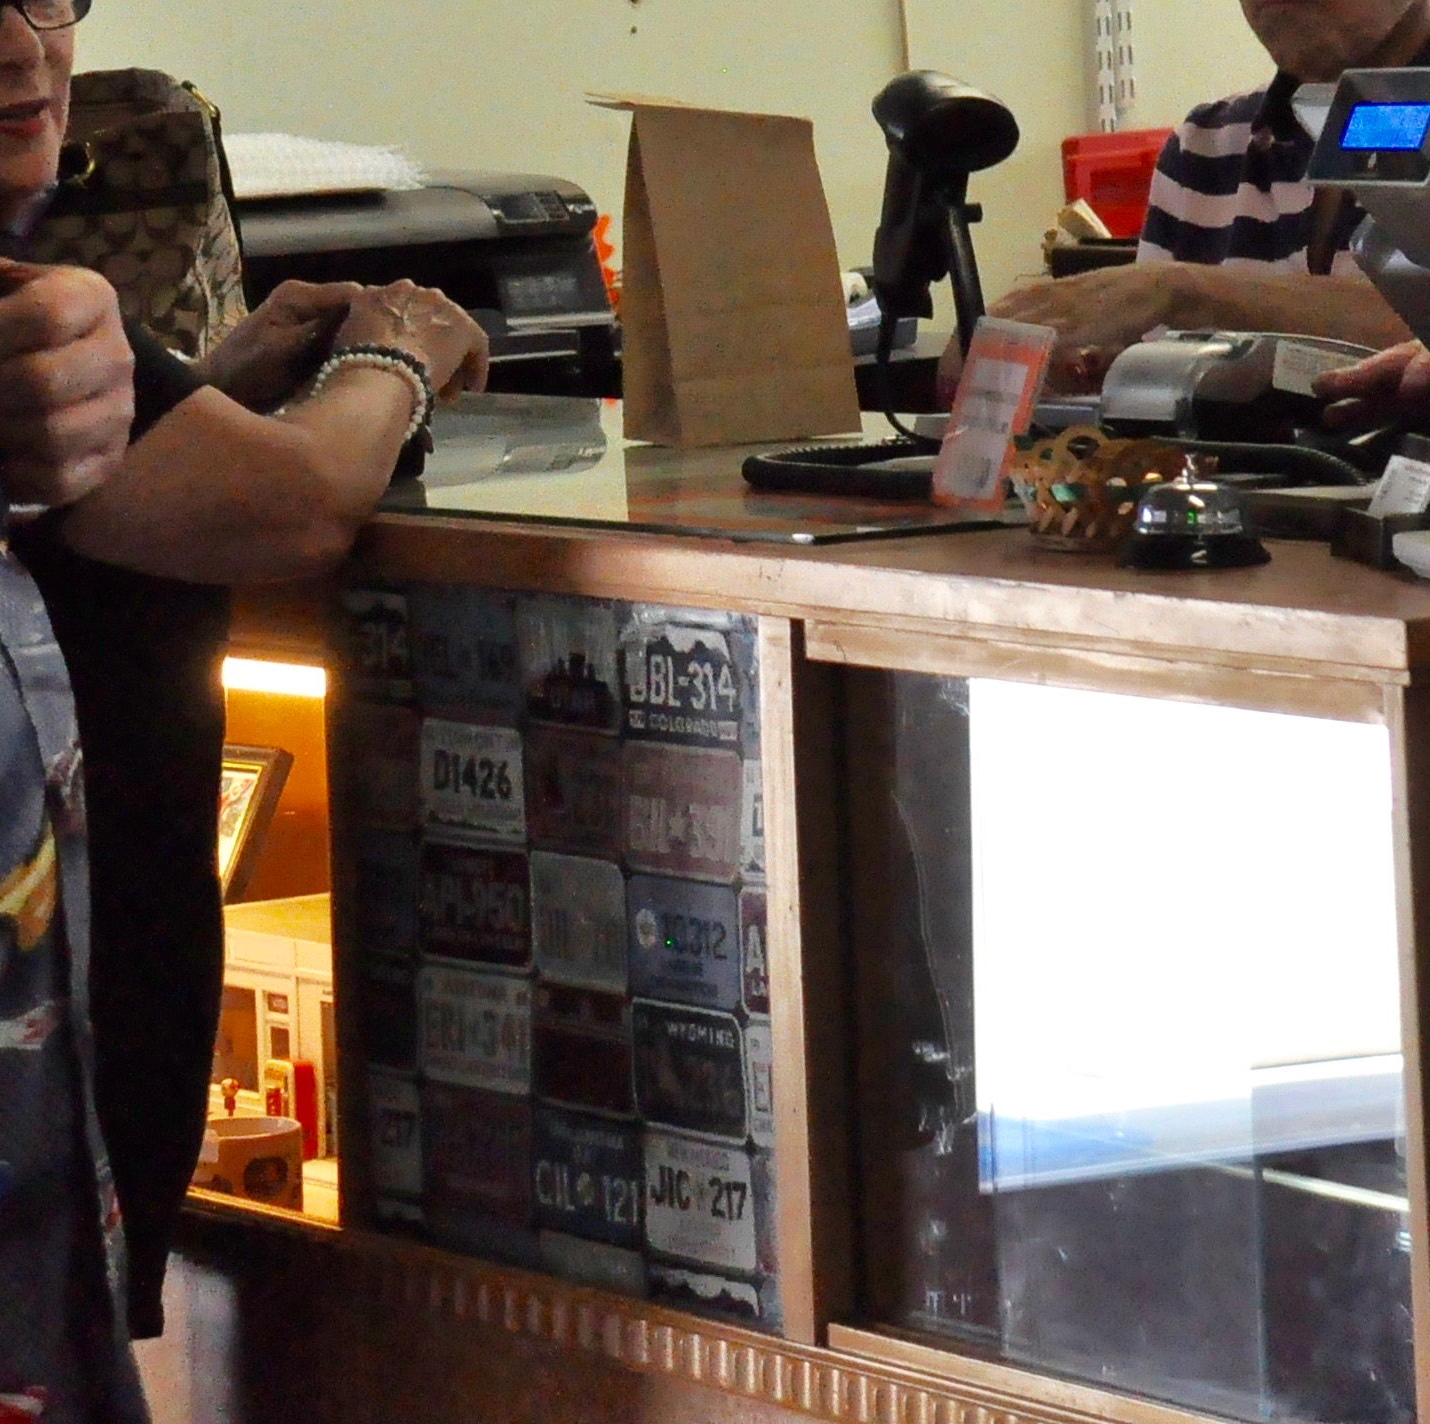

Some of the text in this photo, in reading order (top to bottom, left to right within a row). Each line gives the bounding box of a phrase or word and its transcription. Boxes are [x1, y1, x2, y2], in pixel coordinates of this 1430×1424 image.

[649, 713, 719, 738] COLORADO
[666, 1021, 736, 1049] WYOMING
[602, 1174, 640, 1226] 121
[650, 1164, 747, 1221] JIC 217
